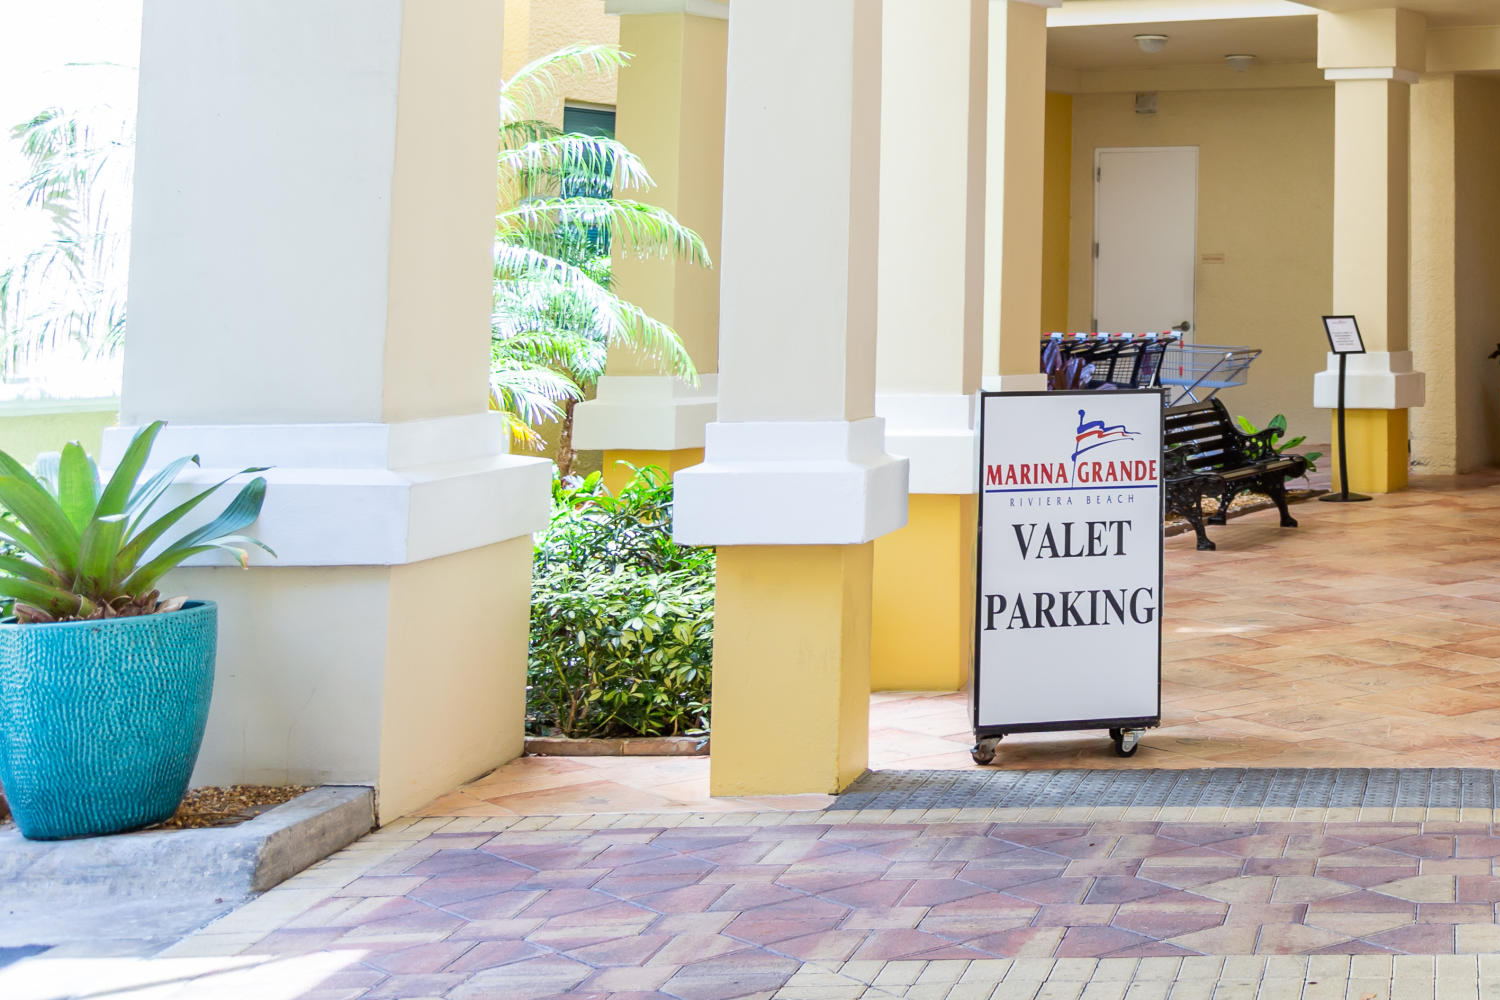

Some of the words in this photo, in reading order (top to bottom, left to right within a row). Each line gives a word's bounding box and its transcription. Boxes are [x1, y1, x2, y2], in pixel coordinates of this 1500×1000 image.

[986, 462, 1068, 486] MARINA
[1077, 459, 1158, 483] GRANDE
[1009, 496, 1073, 507] RIVIERA
[1086, 494, 1135, 505] BEACH
[1011, 519, 1132, 560] VALET
[983, 587, 1156, 631] PARKING
